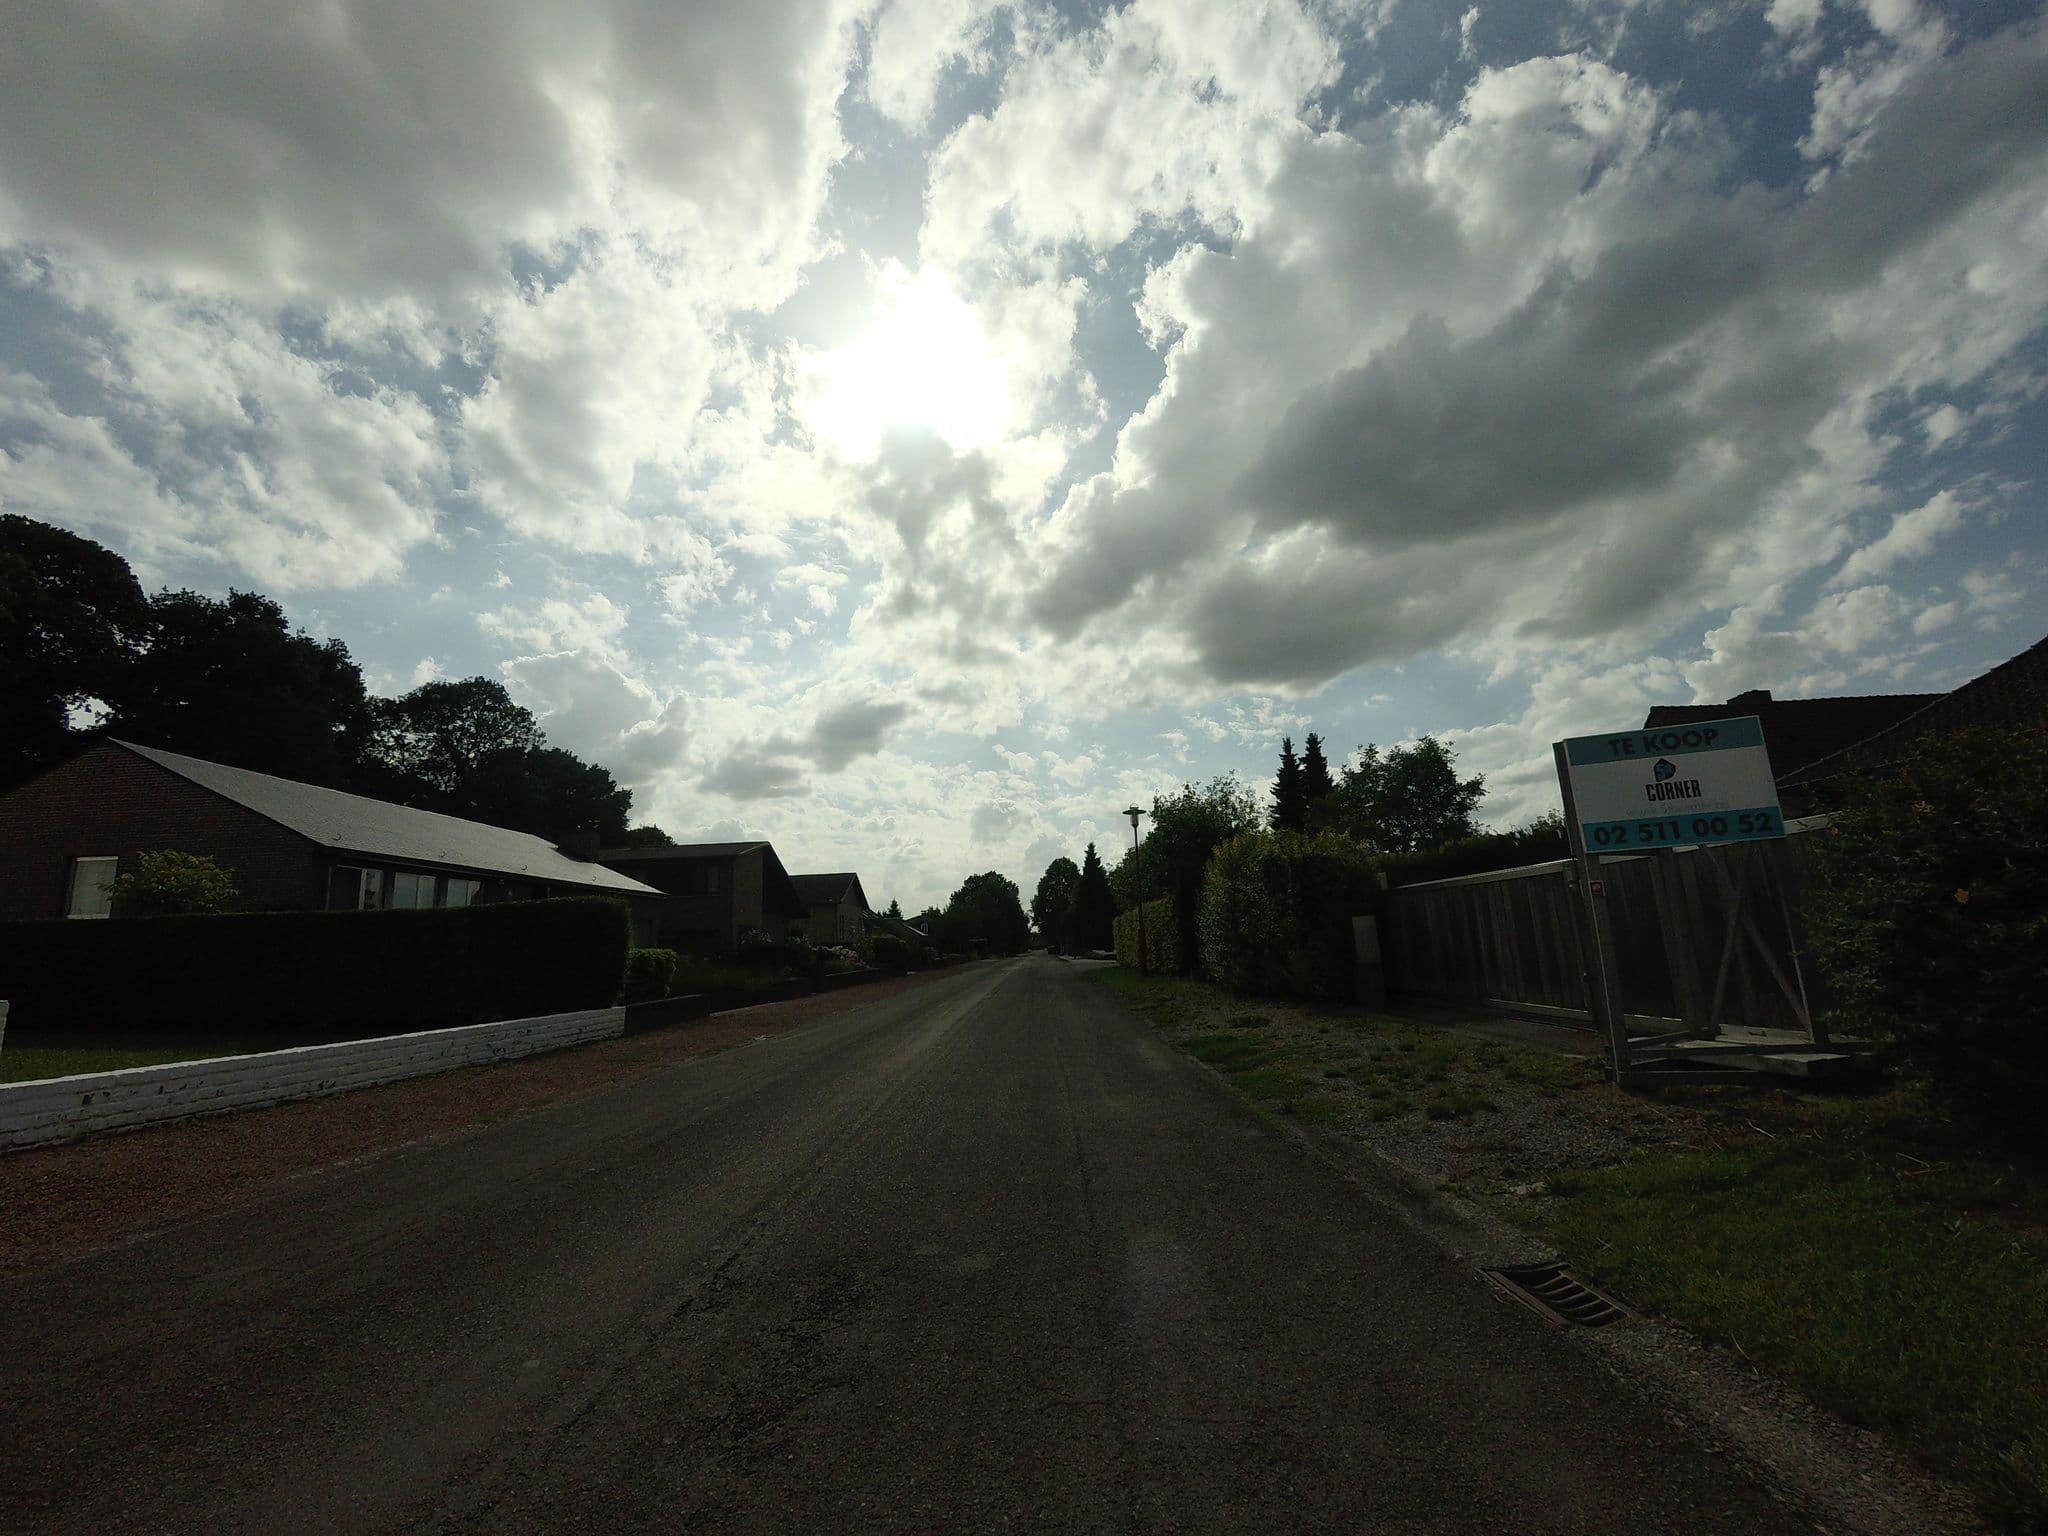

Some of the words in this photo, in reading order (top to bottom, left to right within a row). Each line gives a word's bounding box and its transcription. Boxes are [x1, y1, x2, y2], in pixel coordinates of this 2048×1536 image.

[1608, 737, 1636, 757] TE
[1643, 728, 1719, 751] KOOP
[1645, 779, 1701, 802] CORNER
[1594, 826, 1628, 846] 02
[1637, 820, 1681, 842] 511
[1692, 817, 1728, 838] 00
[1738, 812, 1773, 833] 52
